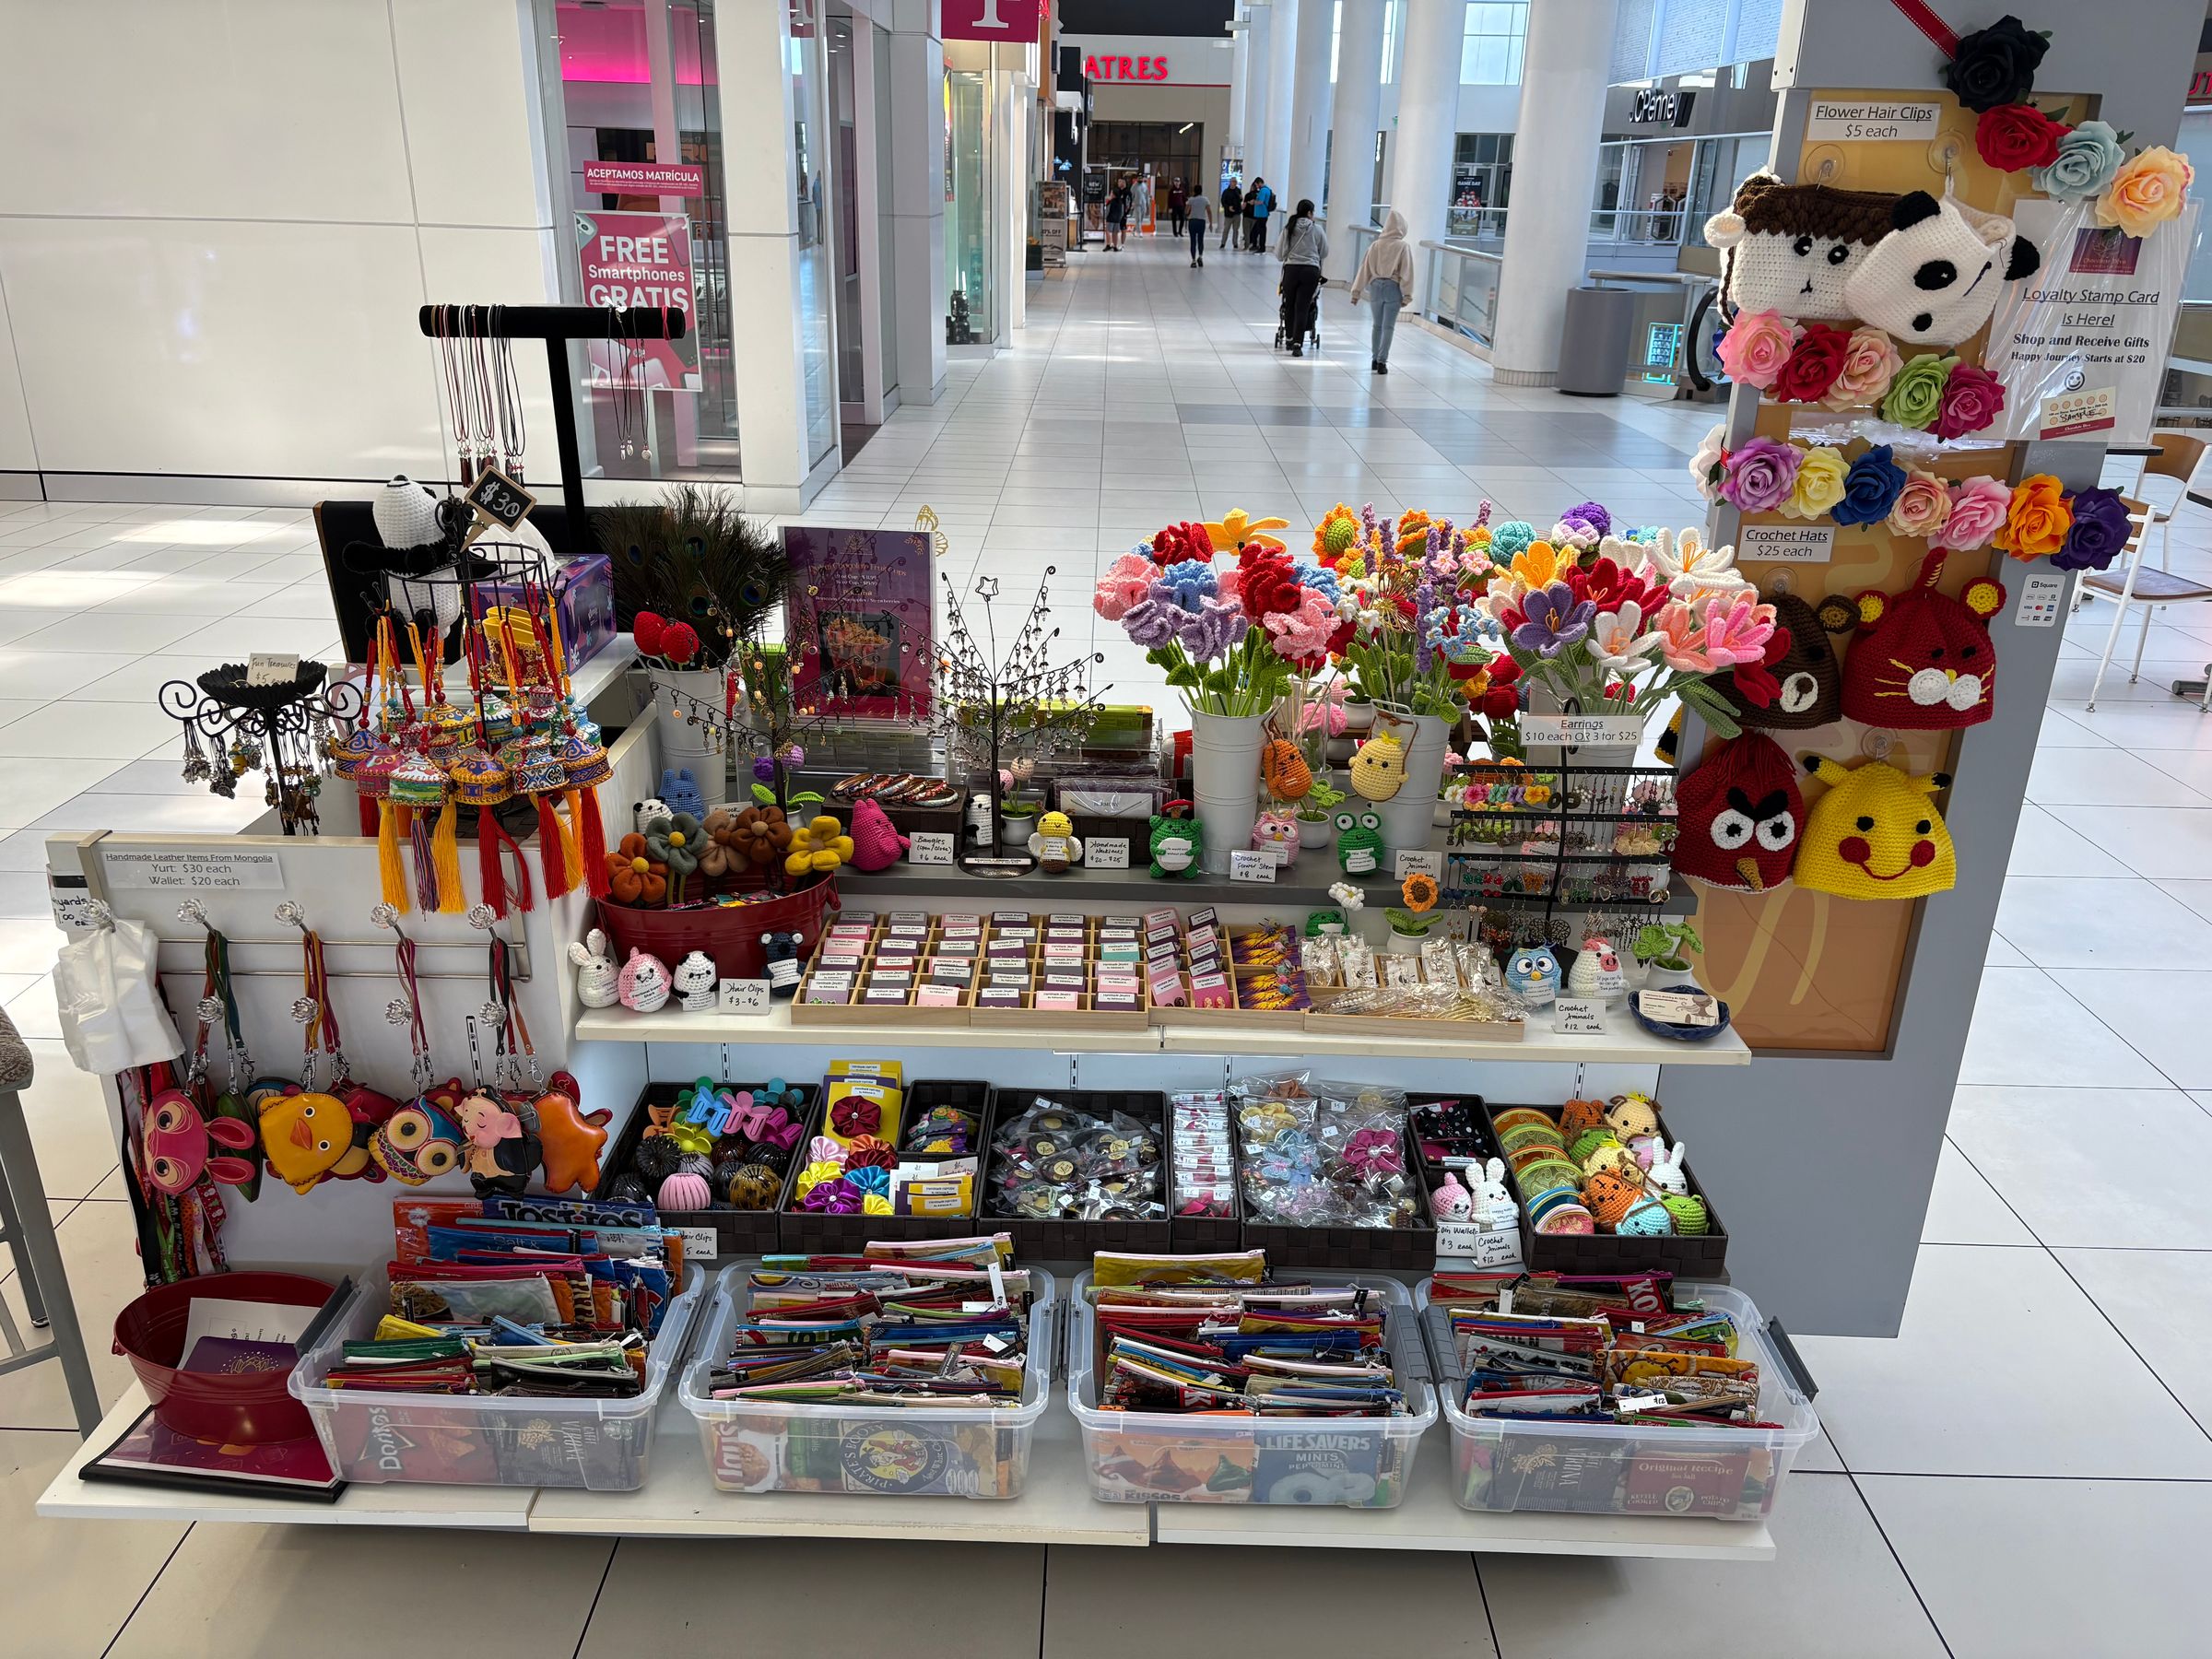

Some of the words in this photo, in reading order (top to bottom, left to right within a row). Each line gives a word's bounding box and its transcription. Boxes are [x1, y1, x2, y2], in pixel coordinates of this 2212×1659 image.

[1629, 88, 1682, 127] JCPenney
[1816, 105, 1865, 119] Flower
[1867, 106, 1897, 120] Hair
[1900, 107, 1933, 123] Clips
[1845, 124, 1862, 137] $5
[1865, 125, 1898, 137] each
[587, 168, 644, 180] ACEPTAMOS
[645, 169, 700, 182] MATRÍCULA
[599, 235, 669, 265] FREE
[588, 264, 686, 283] Smartphones
[589, 284, 689, 313] GRATIS
[2022, 288, 2077, 304] Loyalty
[2079, 289, 2124, 305] Stamp
[2128, 290, 2159, 303] Card
[2062, 313, 2073, 325] Is
[2077, 313, 2116, 326] Here!
[2013, 333, 2045, 347] Shop
[2049, 335, 2071, 347] and
[2076, 335, 2120, 347] Receive
[2124, 336, 2150, 347] Gifts
[2011, 351, 2041, 362] Happy
[2043, 352, 2081, 363] Journey
[2084, 354, 2112, 363] Starts
[2114, 355, 2124, 363] at
[2126, 355, 2145, 363] $20
[479, 481, 521, 518] $30
[1746, 529, 1796, 541] Crochet
[1799, 530, 1829, 541] Hats
[1757, 545, 1780, 557] $25
[1783, 547, 1813, 557] each
[1560, 720, 1604, 730] Earrings
[1525, 732, 1545, 741] $10
[1547, 733, 1571, 741] each
[1574, 733, 1591, 742] OR
[1593, 733, 1599, 741] 3
[1602, 732, 1615, 741] for
[1618, 732, 1637, 741] $25
[914, 836, 946, 845] Bangles
[153, 853, 184, 862] Leather
[233, 854, 274, 863] Mongolia
[1399, 854, 1425, 863] Crochet
[152, 864, 177, 873] Yurt:
[182, 864, 203, 874] $30
[206, 865, 231, 873] each
[148, 877, 185, 885] Wallet:
[191, 877, 211, 886] $20
[724, 982, 747, 994] Hair
[747, 982, 765, 994] Clips
[1559, 1004, 1588, 1013] Crochet
[1564, 1022, 1579, 1030] $12
[695, 1232, 712, 1242] Clips
[1477, 1237, 1504, 1247] Crochet
[1441, 1238, 1453, 1250] $3
[1627, 1278, 1662, 1314] KO
[369, 1406, 403, 1470] Doritos
[1265, 1435, 1305, 1450] LIFE
[1306, 1433, 1371, 1451] SAVERS
[1295, 1451, 1338, 1463] MINTS
[1639, 1462, 1688, 1475] Original
[1690, 1464, 1735, 1476] Recipe
